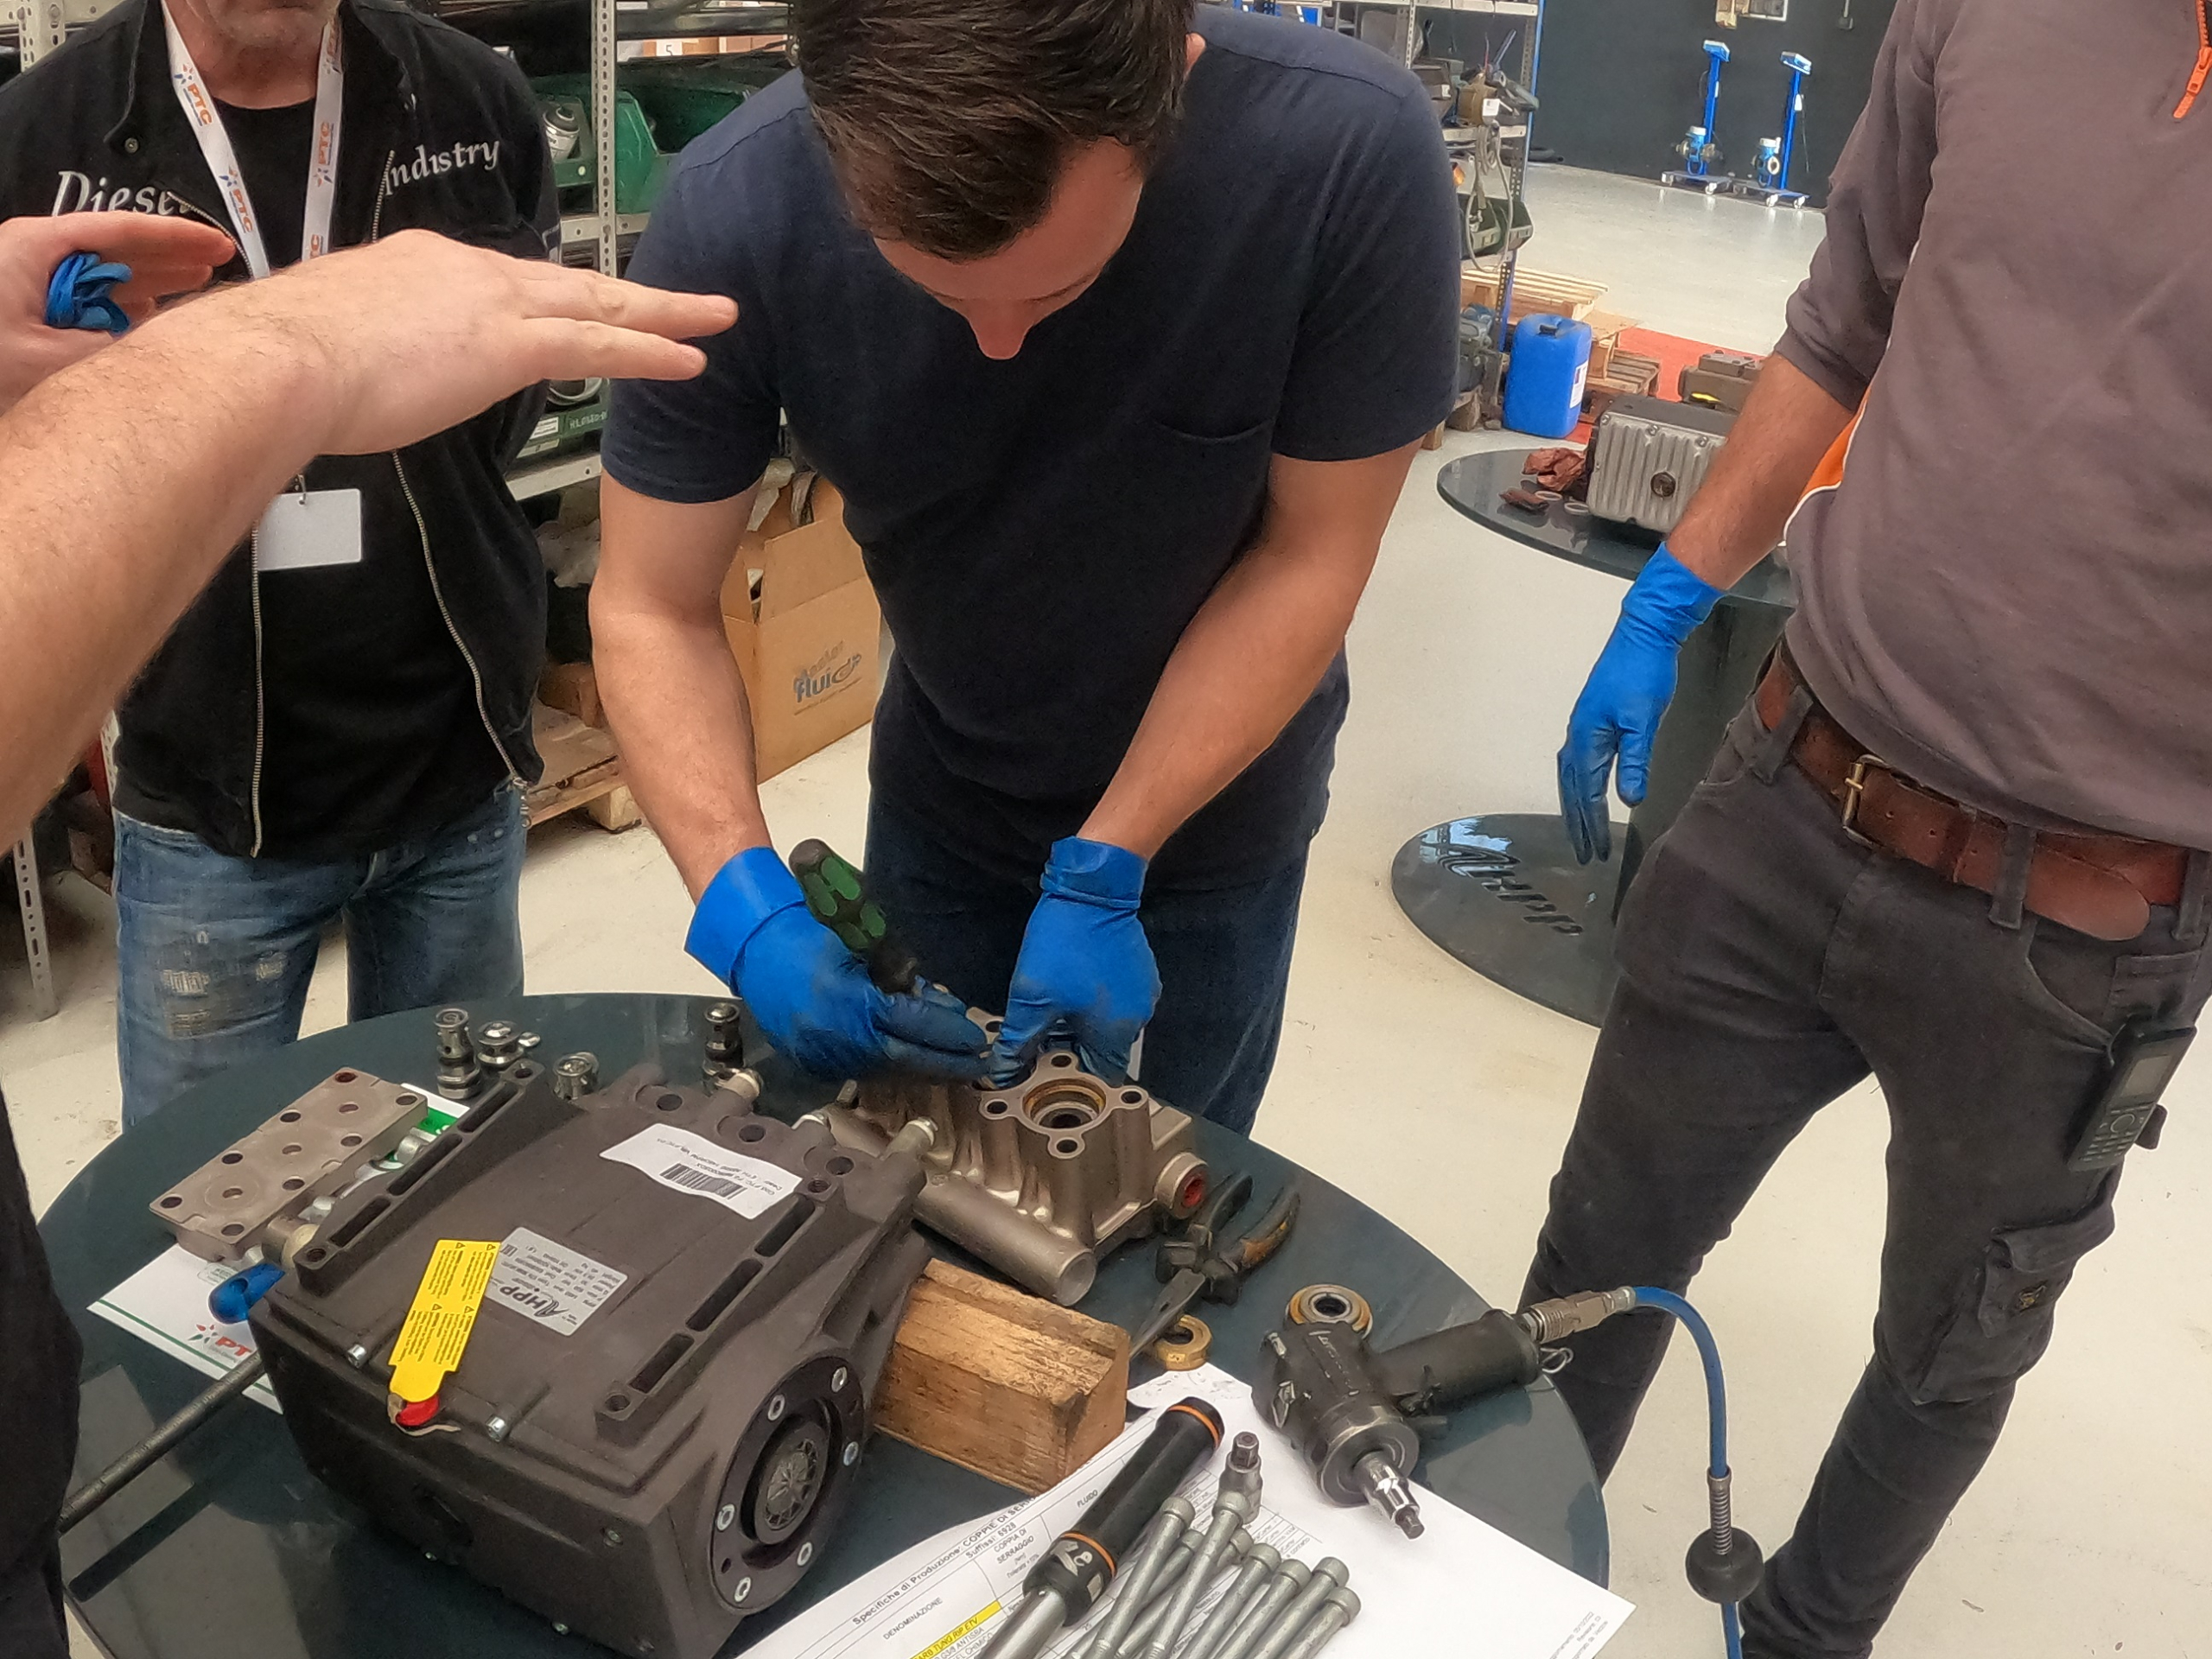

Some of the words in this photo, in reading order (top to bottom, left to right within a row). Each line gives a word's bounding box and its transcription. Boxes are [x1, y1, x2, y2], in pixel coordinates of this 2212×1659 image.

[188, 83, 213, 125] PTC
[232, 188, 253, 233] PTC
[215, 1336, 253, 1357] PT
[994, 1533, 1020, 1553] COPPIA
[997, 1535, 1034, 1564] SERRAGGIO
[853, 1591, 900, 1625] Specifiche
[901, 1580, 911, 1592] di
[963, 1522, 997, 1548] COPPIE
[998, 1513, 1008, 1524] DI
[883, 1597, 944, 1640] DENOMINAZIONE
